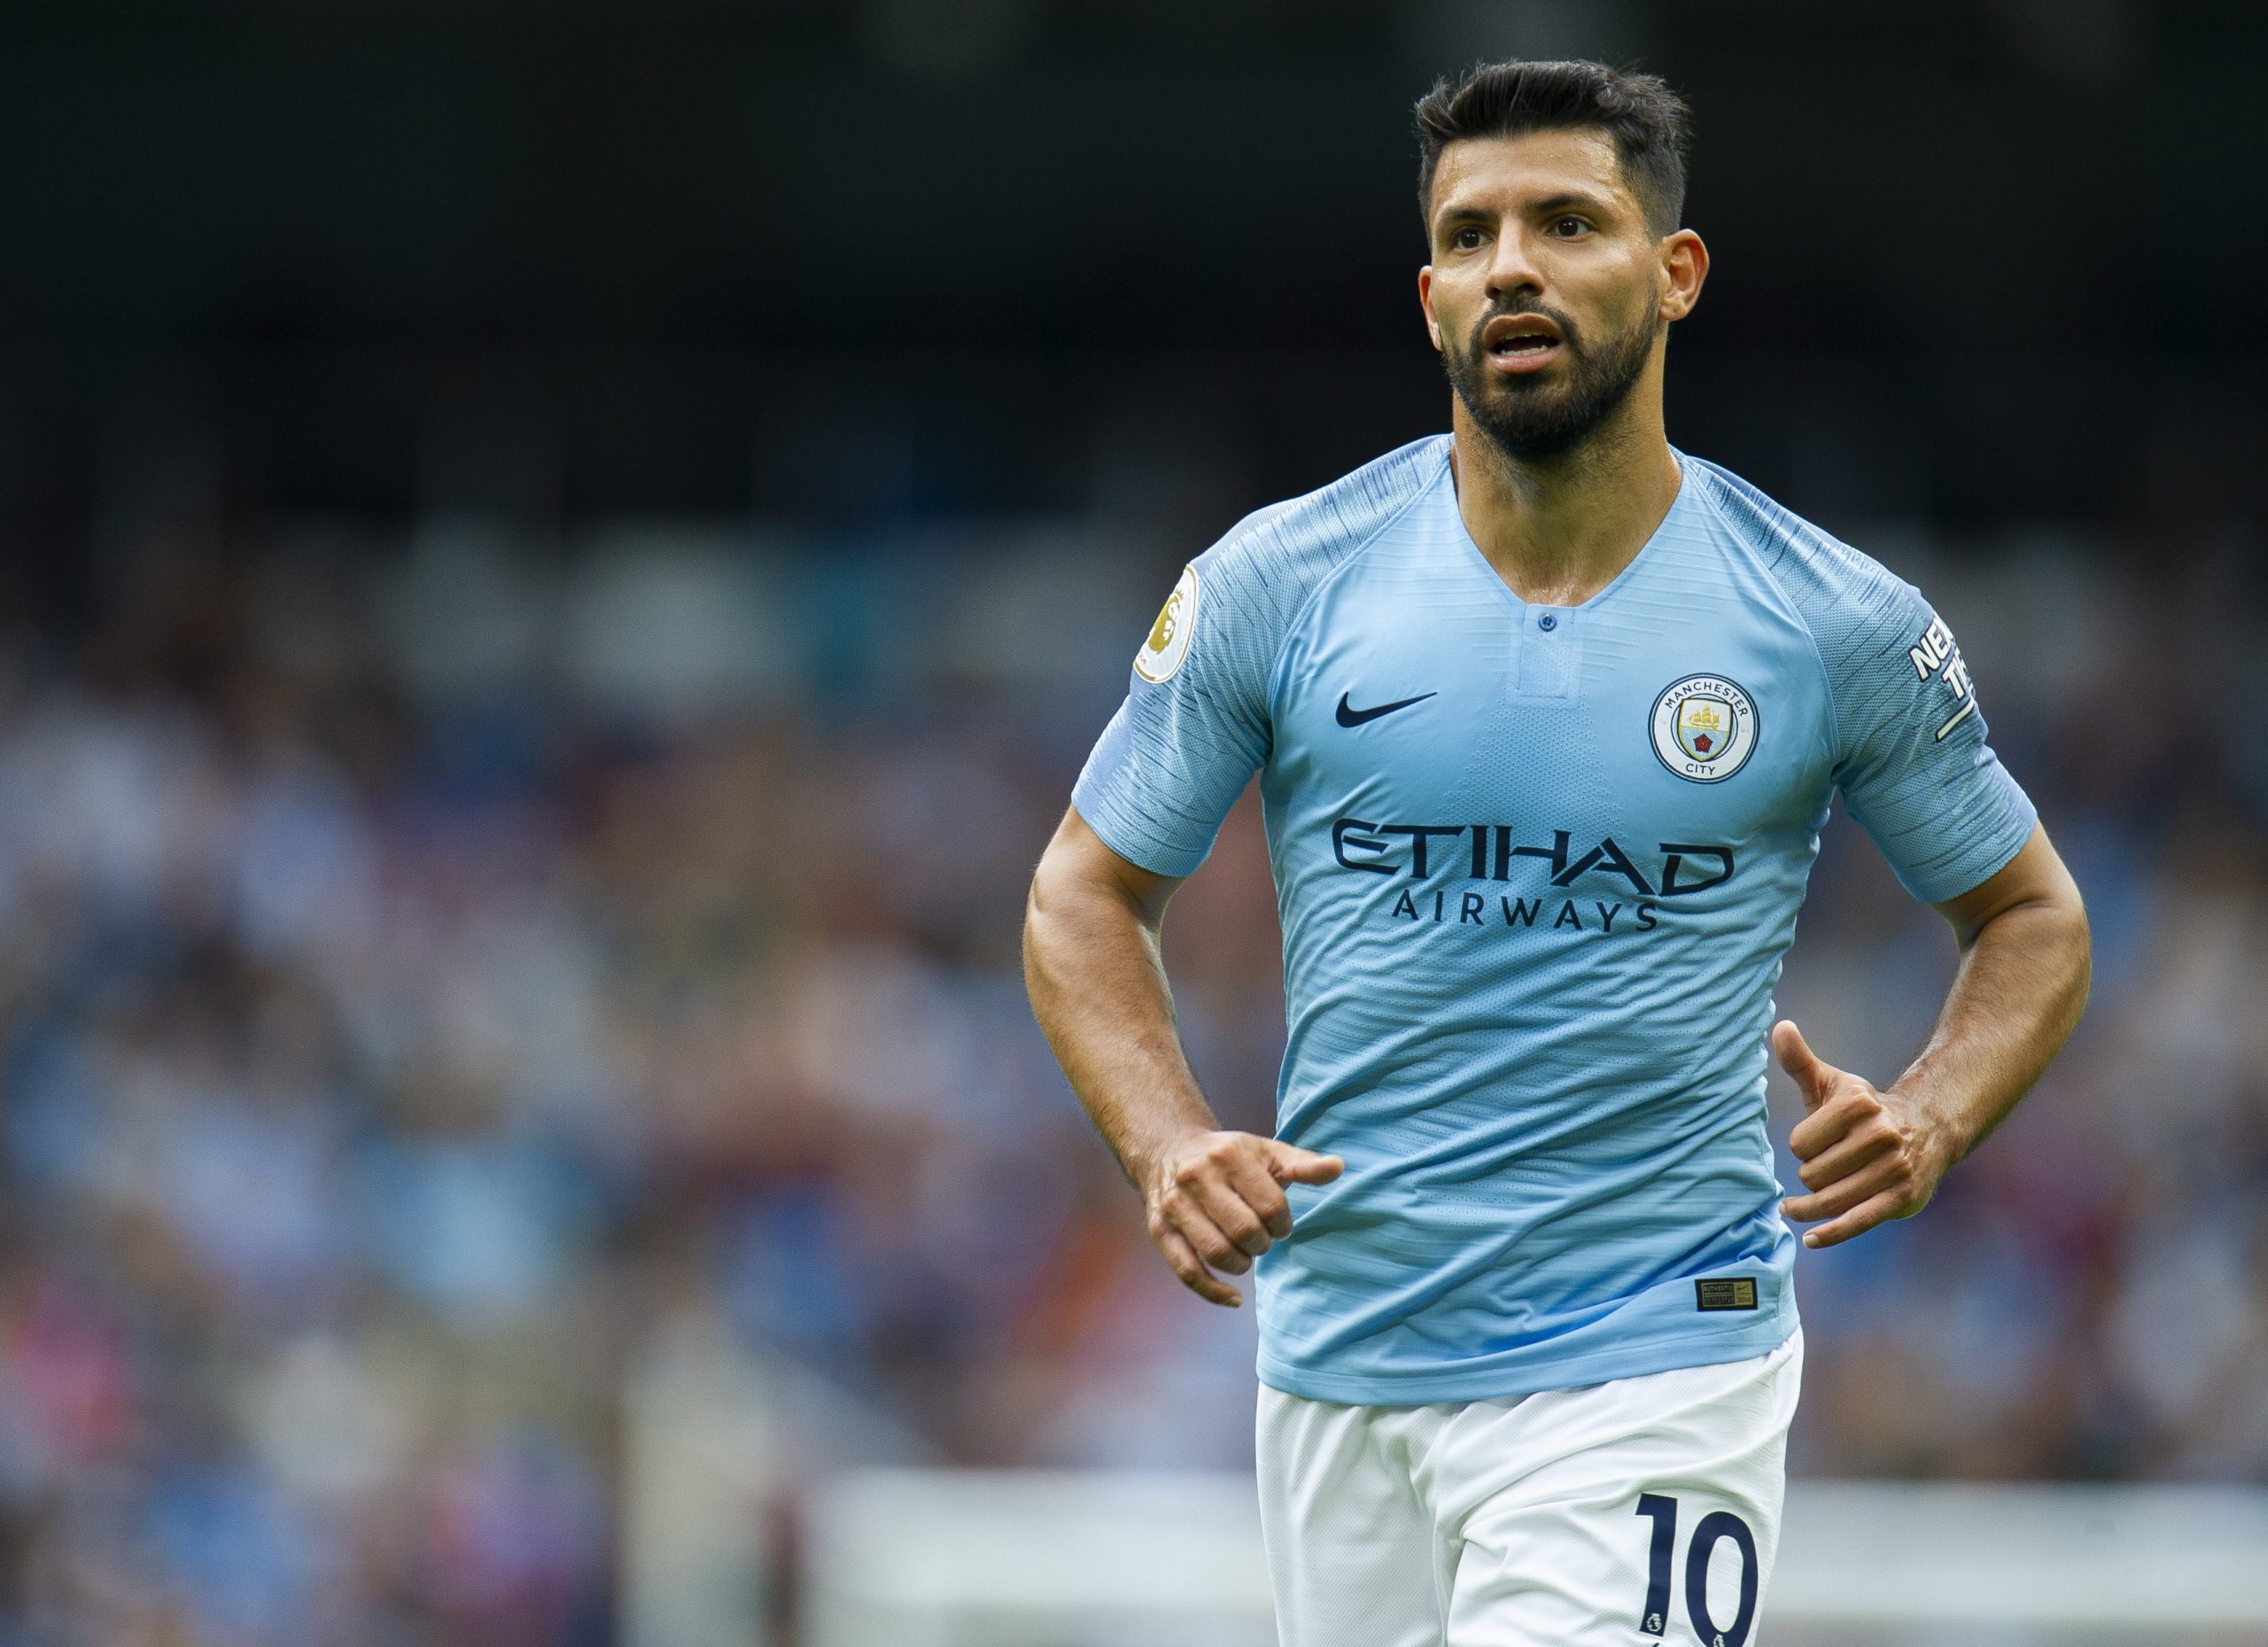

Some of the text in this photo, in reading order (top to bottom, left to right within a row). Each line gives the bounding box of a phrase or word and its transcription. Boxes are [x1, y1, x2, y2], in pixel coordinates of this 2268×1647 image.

[1664, 681, 1749, 718] MANCHESTER
[1685, 763, 1716, 775] CITY
[1332, 818, 1736, 897] ETIHAD
[1391, 889, 1658, 933] AIRWAYS
[1635, 1493, 1759, 1647] 10
